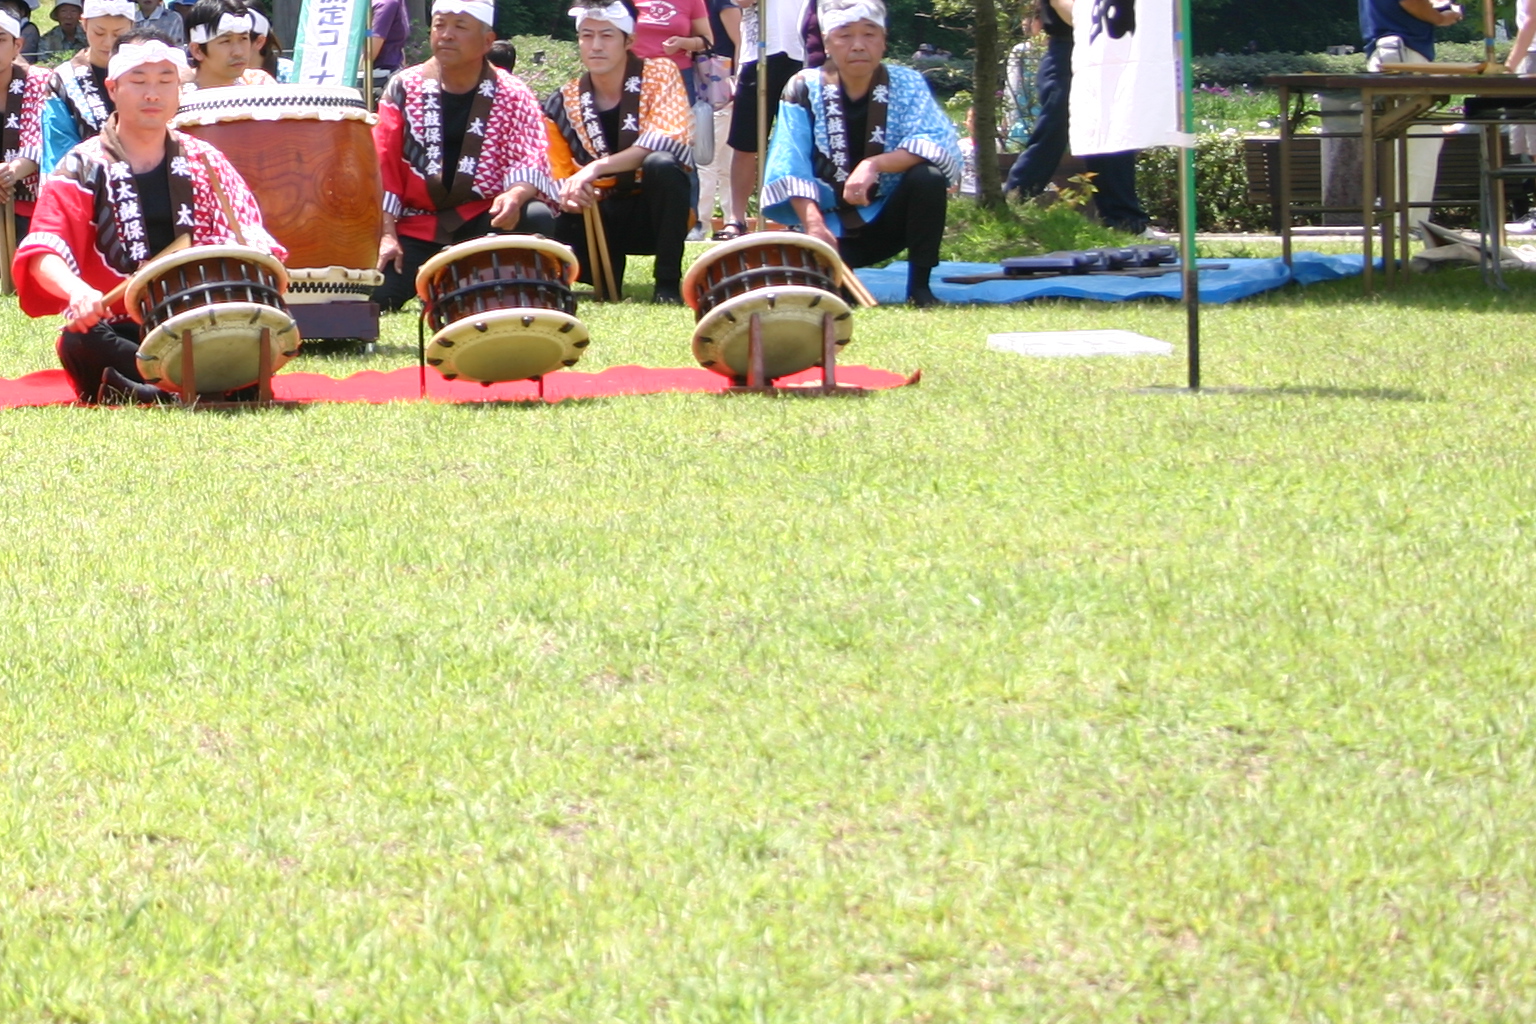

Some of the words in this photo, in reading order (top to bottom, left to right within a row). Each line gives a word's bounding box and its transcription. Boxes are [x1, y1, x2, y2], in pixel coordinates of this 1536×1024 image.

[422, 78, 442, 175] 栄太鼓保存会
[457, 79, 494, 175] 栄太鼓
[621, 76, 641, 132] 栄太
[822, 83, 849, 183] 栄太鼓保存会
[170, 156, 195, 227] 栄太
